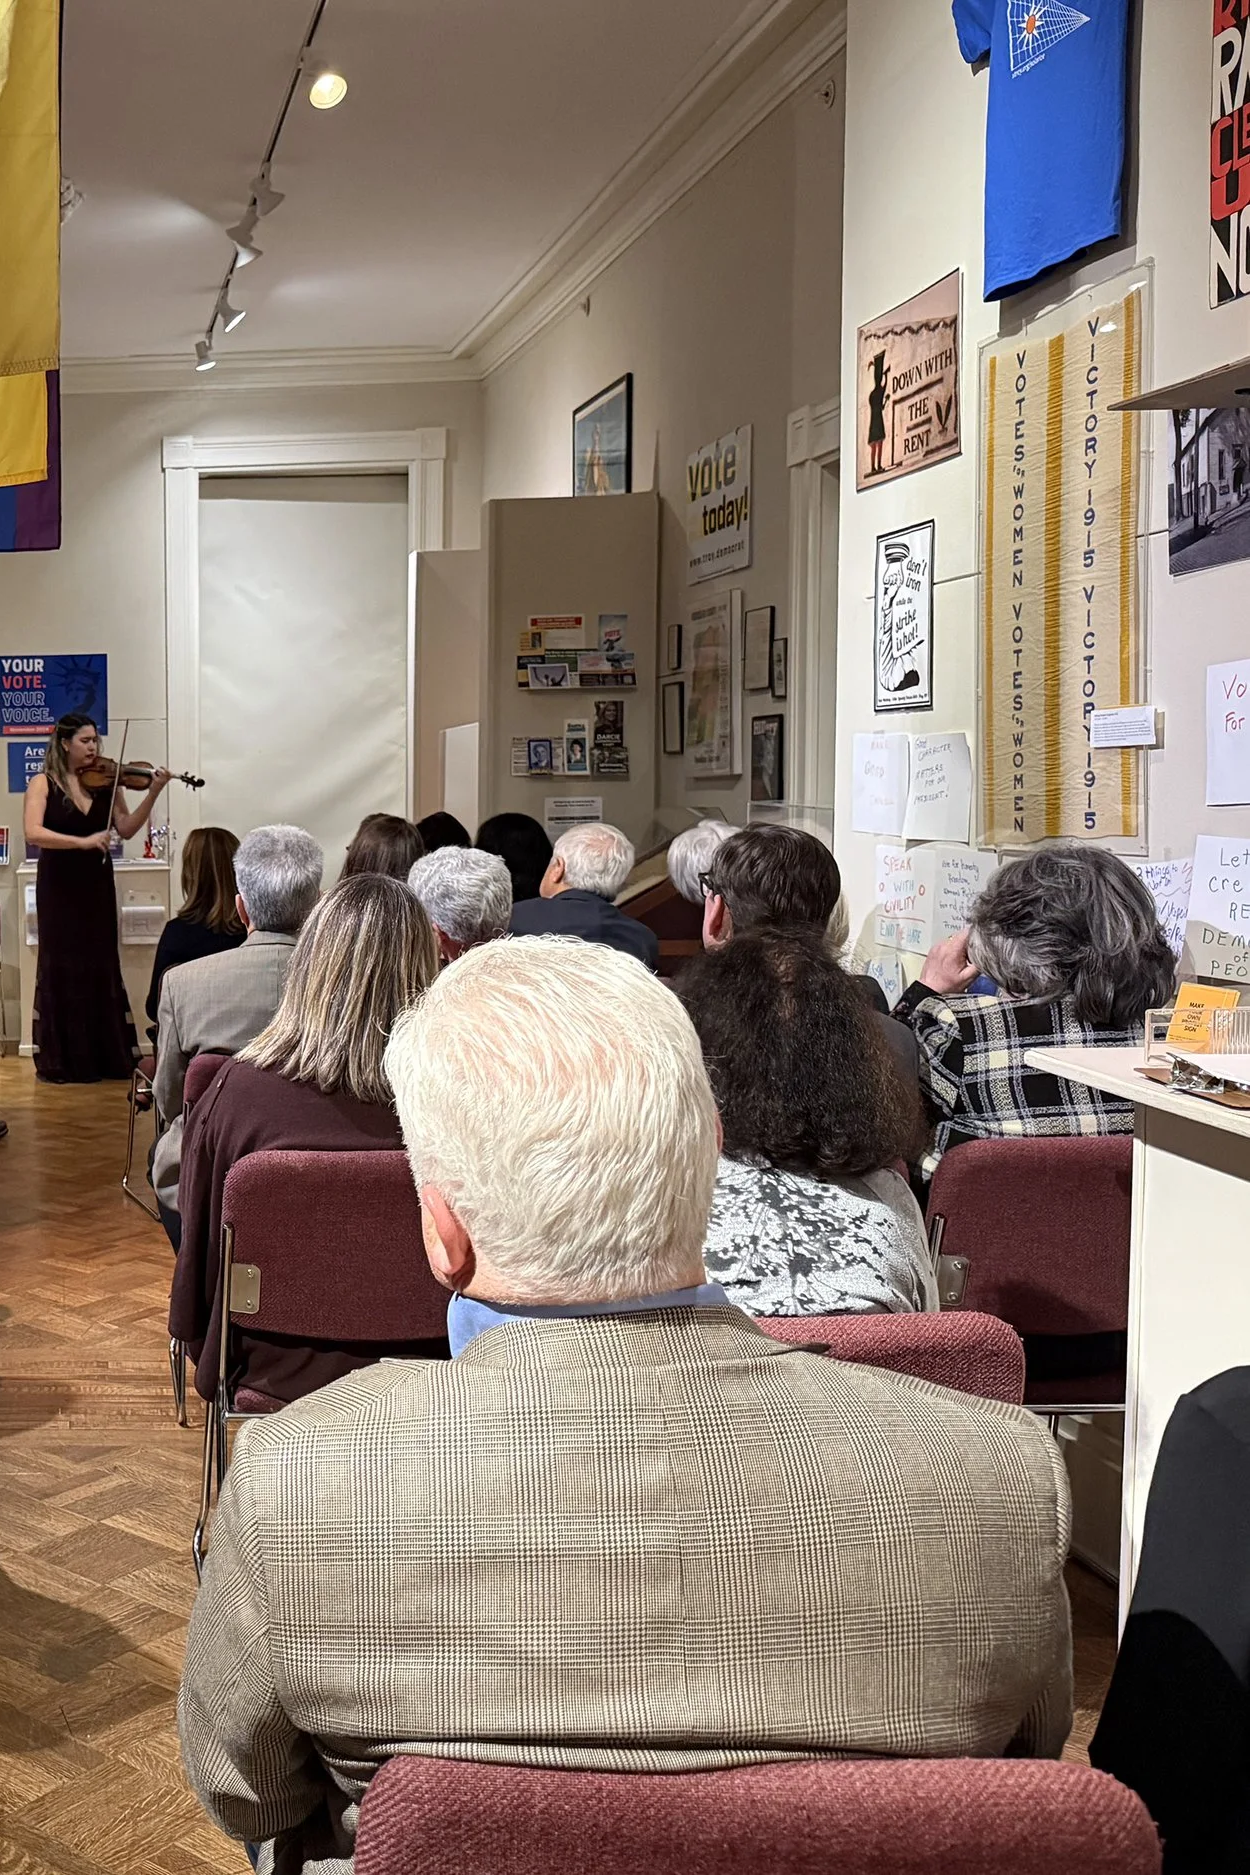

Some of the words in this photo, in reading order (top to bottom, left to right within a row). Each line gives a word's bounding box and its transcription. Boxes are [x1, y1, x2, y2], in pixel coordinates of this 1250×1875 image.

[892, 363, 923, 394] DOWN
[925, 348, 953, 377] WITH
[908, 396, 929, 422] THE
[1014, 350, 1027, 462] VOTES
[1083, 316, 1100, 479] VICTORY
[903, 429, 932, 455] RENT
[688, 444, 736, 502] vote
[702, 486, 748, 536] today!
[1012, 483, 1025, 588] WOMEN
[1083, 490, 1096, 568] 1915
[906, 557, 927, 576] don't
[906, 573, 921, 592] iron
[896, 608, 917, 633] strike
[1, 659, 44, 673] YOUR
[1012, 603, 1023, 711] VOTES
[2, 675, 46, 689] VOTE.
[1, 691, 45, 706] YOUR
[2, 707, 54, 723] VOICE.
[1225, 711, 1245, 733] For
[25, 746, 45, 756] Are
[1012, 732, 1025, 832] WOMEN
[1084, 752, 1097, 829] 1915
[883, 855, 912, 876] SPEAK
[893, 880, 914, 893] WITH
[884, 896, 916, 914] CIVILITY
[1202, 927, 1250, 949] DEM
[1234, 952, 1249, 963] of
